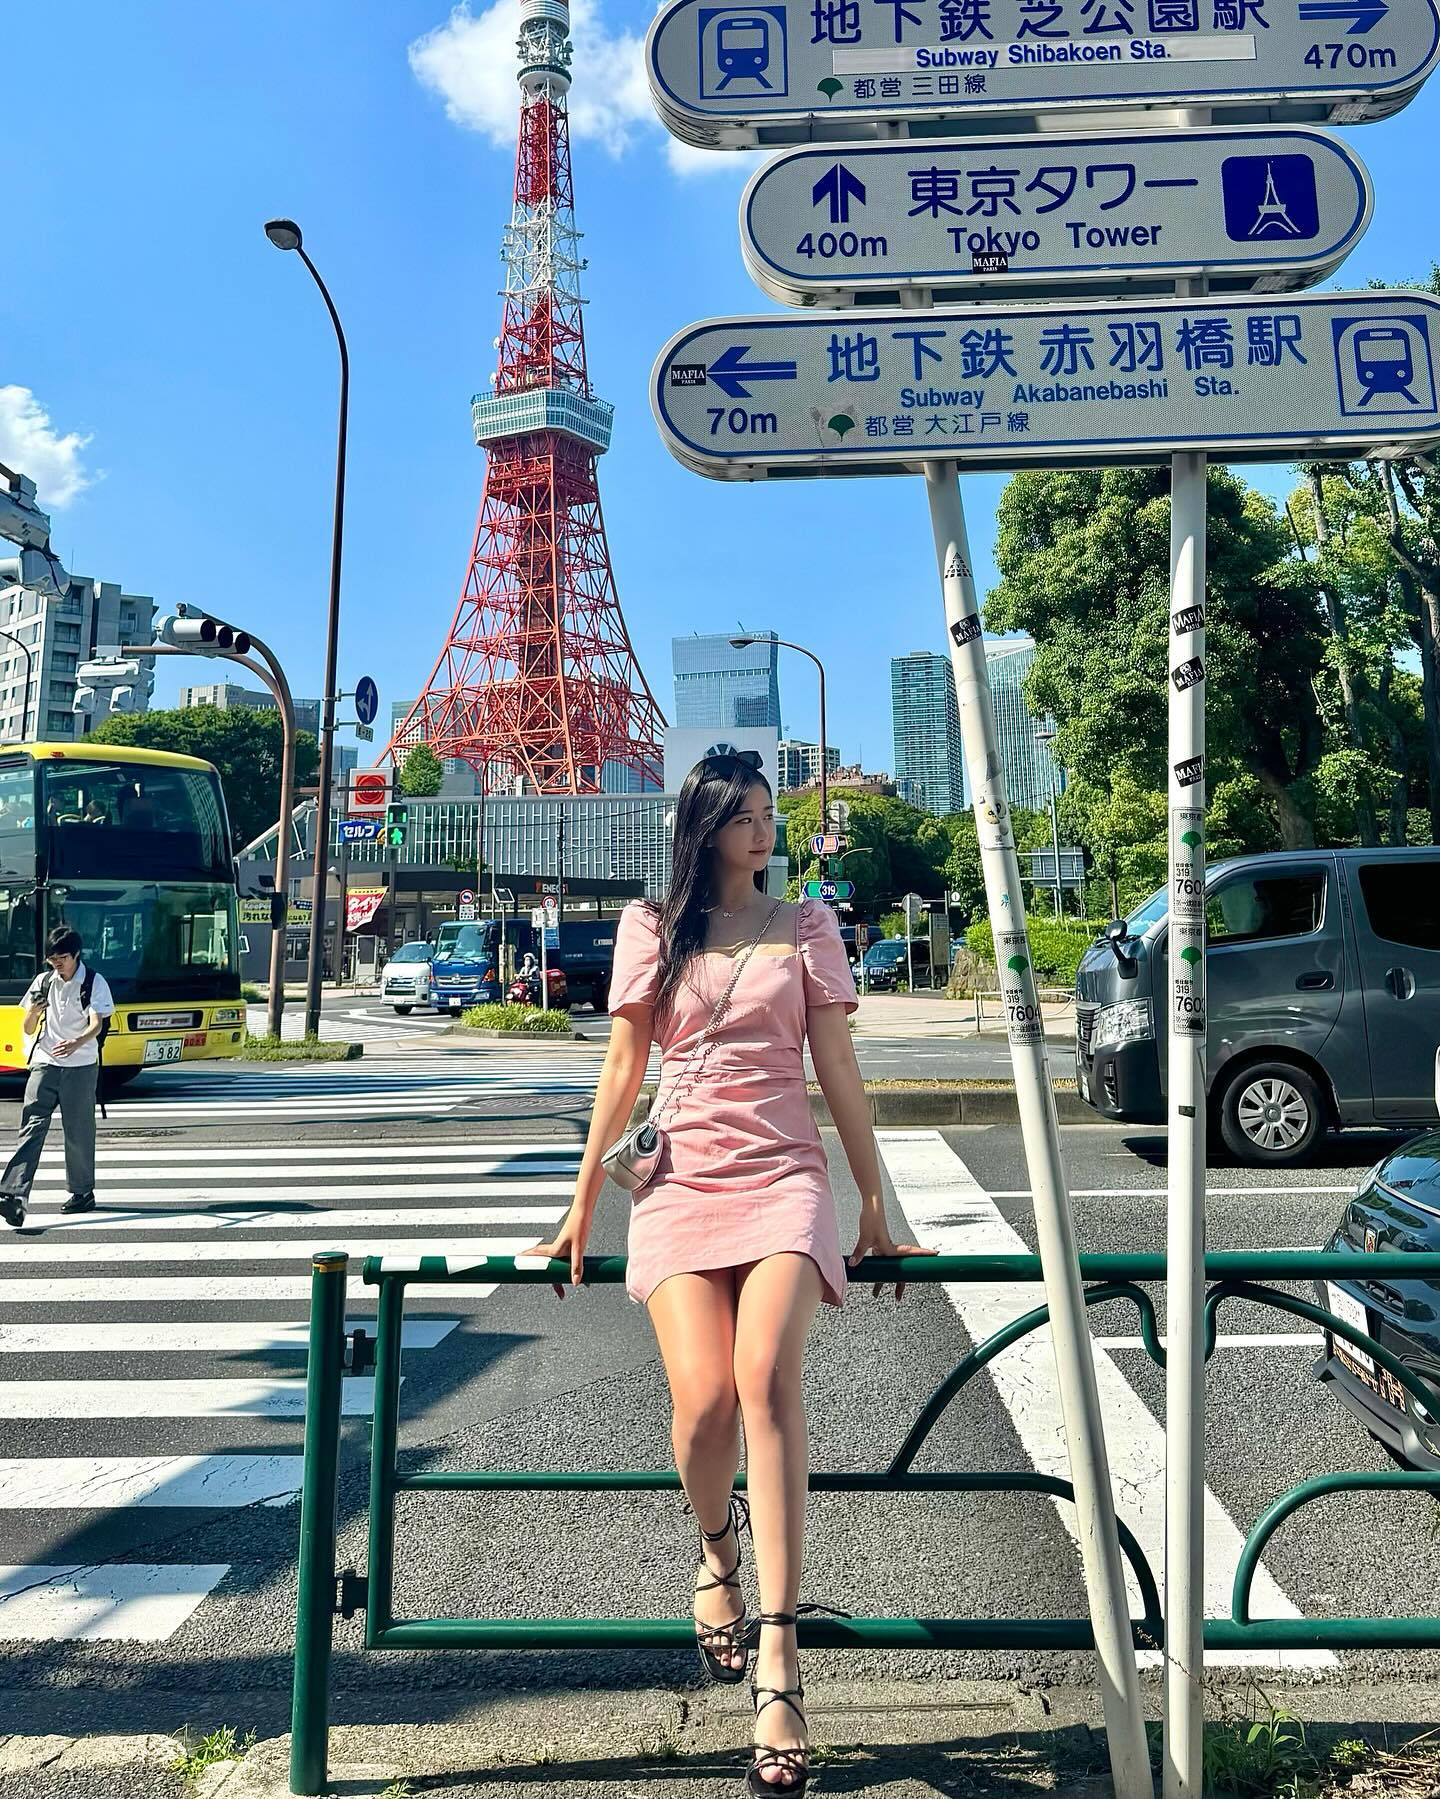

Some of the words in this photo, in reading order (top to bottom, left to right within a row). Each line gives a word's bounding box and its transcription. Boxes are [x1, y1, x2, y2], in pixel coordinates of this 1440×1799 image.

[916, 44, 999, 68] Subway
[1008, 40, 1121, 65] Shibakoen
[1130, 40, 1171, 60] Sta.
[1304, 43, 1397, 70] 470m
[854, 79, 901, 99] 都営
[912, 74, 987, 97] 三田線
[908, 163, 1198, 219] 東京タワー
[796, 232, 888, 259] 400m
[947, 226, 1040, 258] Tokyo
[1065, 222, 1162, 249] Tower
[973, 257, 1007, 267] MAFIA
[827, 328, 1018, 382] 地下鉄
[1039, 315, 1307, 376] 赤羽橋駅
[672, 369, 706, 380] MAFIA
[900, 387, 985, 409] Subway
[1013, 379, 1168, 404] Akabanebashi
[1195, 376, 1240, 397] Sta.
[706, 408, 777, 434] 70m
[865, 415, 915, 436] 都営
[925, 411, 1030, 434] 大江戸線
[1173, 608, 1204, 631] MAFIA
[955, 625, 980, 642] MAFIA
[1175, 668, 1202, 688] MAFIA
[1175, 763, 1201, 781] MAFI
[343, 826, 375, 838] セルフ
[1176, 868, 1190, 877] 319
[821, 885, 836, 896] 319
[1006, 994, 1020, 1004] 319
[1175, 984, 1190, 994] 319
[158, 1046, 180, 1060] 982
